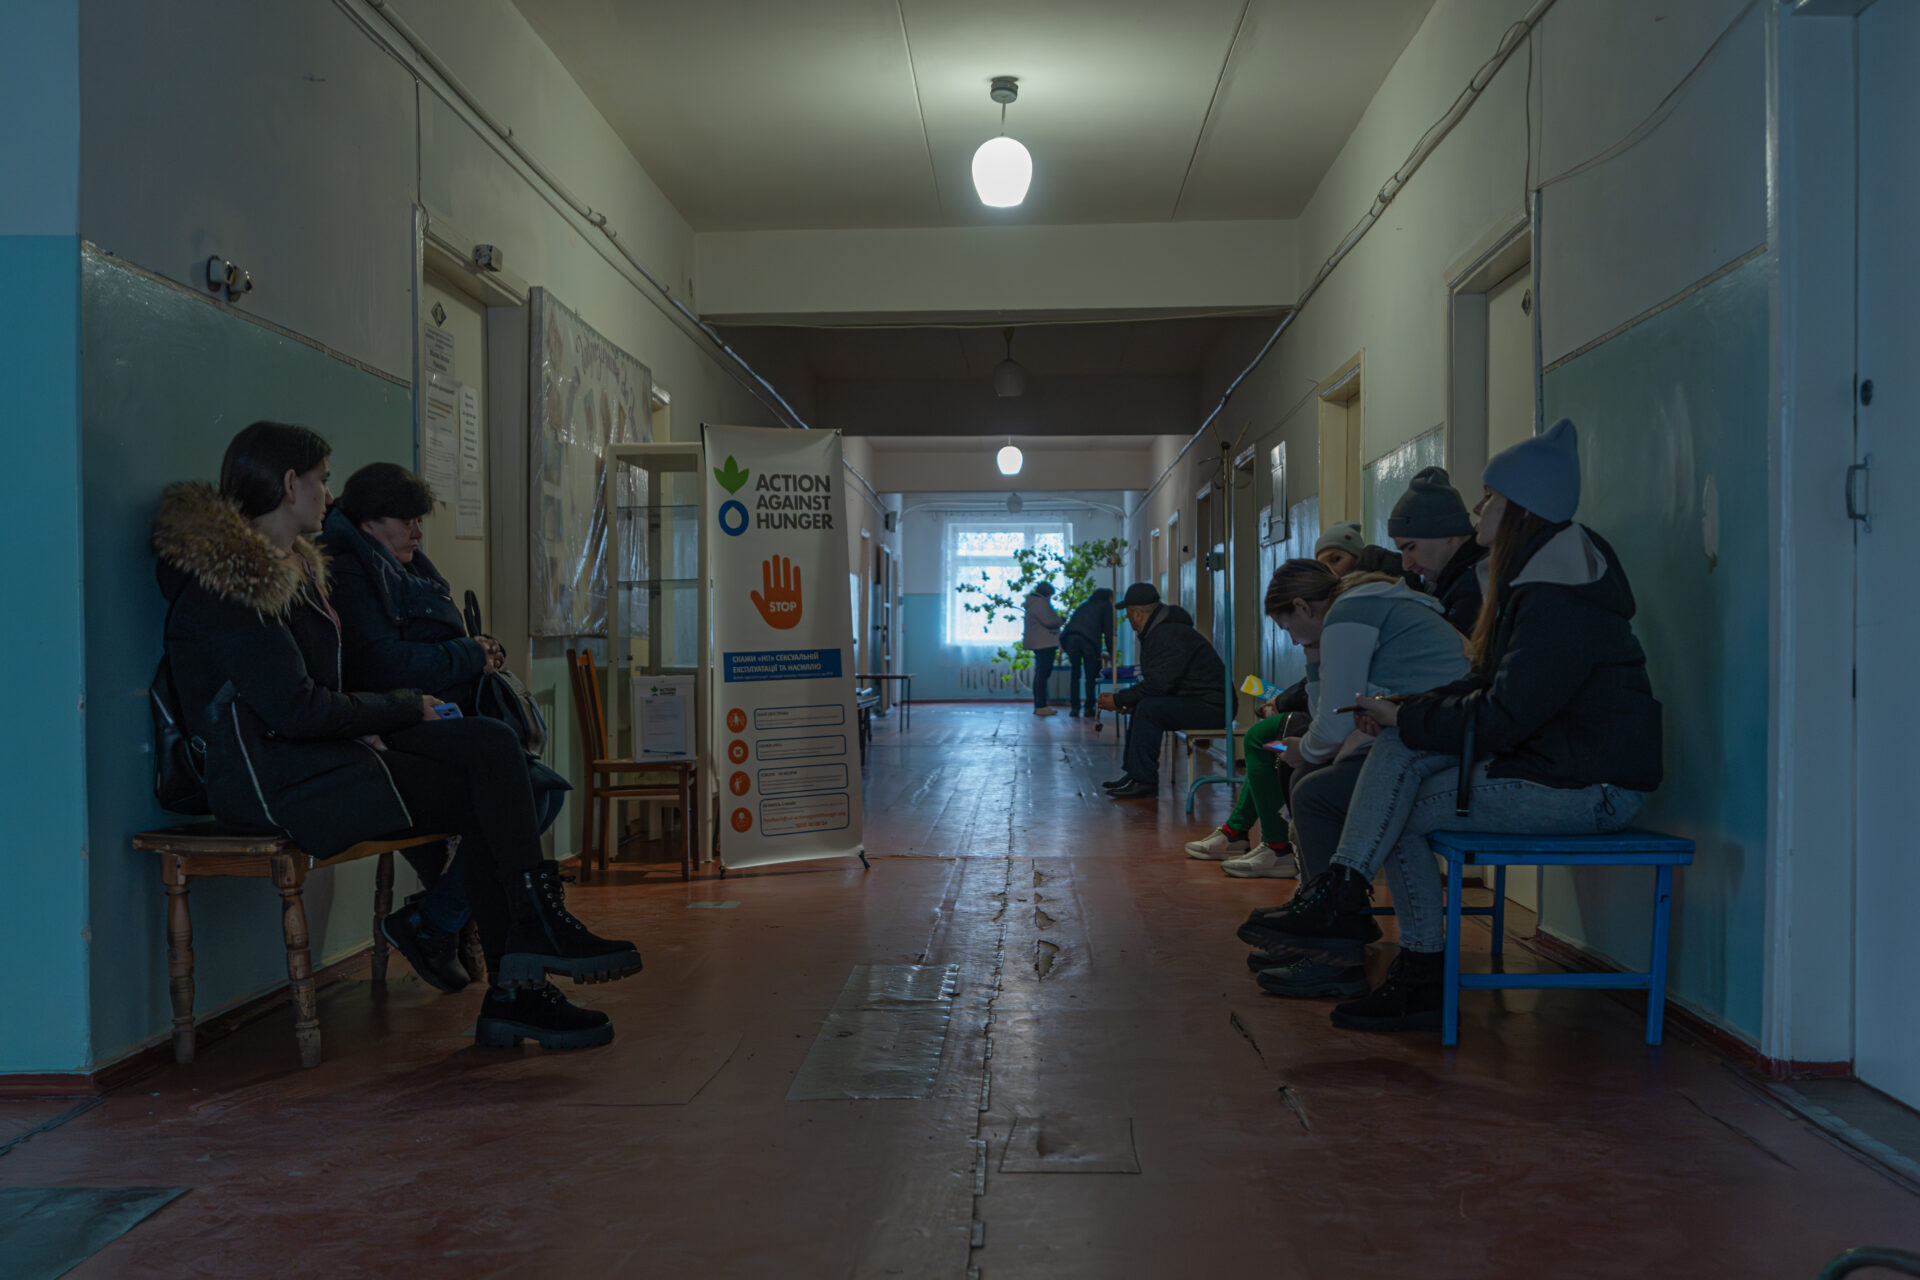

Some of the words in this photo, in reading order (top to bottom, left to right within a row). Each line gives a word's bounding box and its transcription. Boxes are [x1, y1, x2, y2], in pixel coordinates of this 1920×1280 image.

[755, 473, 831, 493] ACTION
[756, 494, 831, 511] AGAINST
[756, 512, 834, 530] HUNGER
[769, 601, 797, 612] STOP
[732, 655, 757, 663] СКАЖИ
[775, 652, 819, 662] СЕКСУАЛЬНІЙ
[732, 663, 778, 674] ЕКСПЛУАТАЦІЇ
[779, 664, 787, 672] ТА
[788, 663, 822, 672] НАСИЛЛЮ
